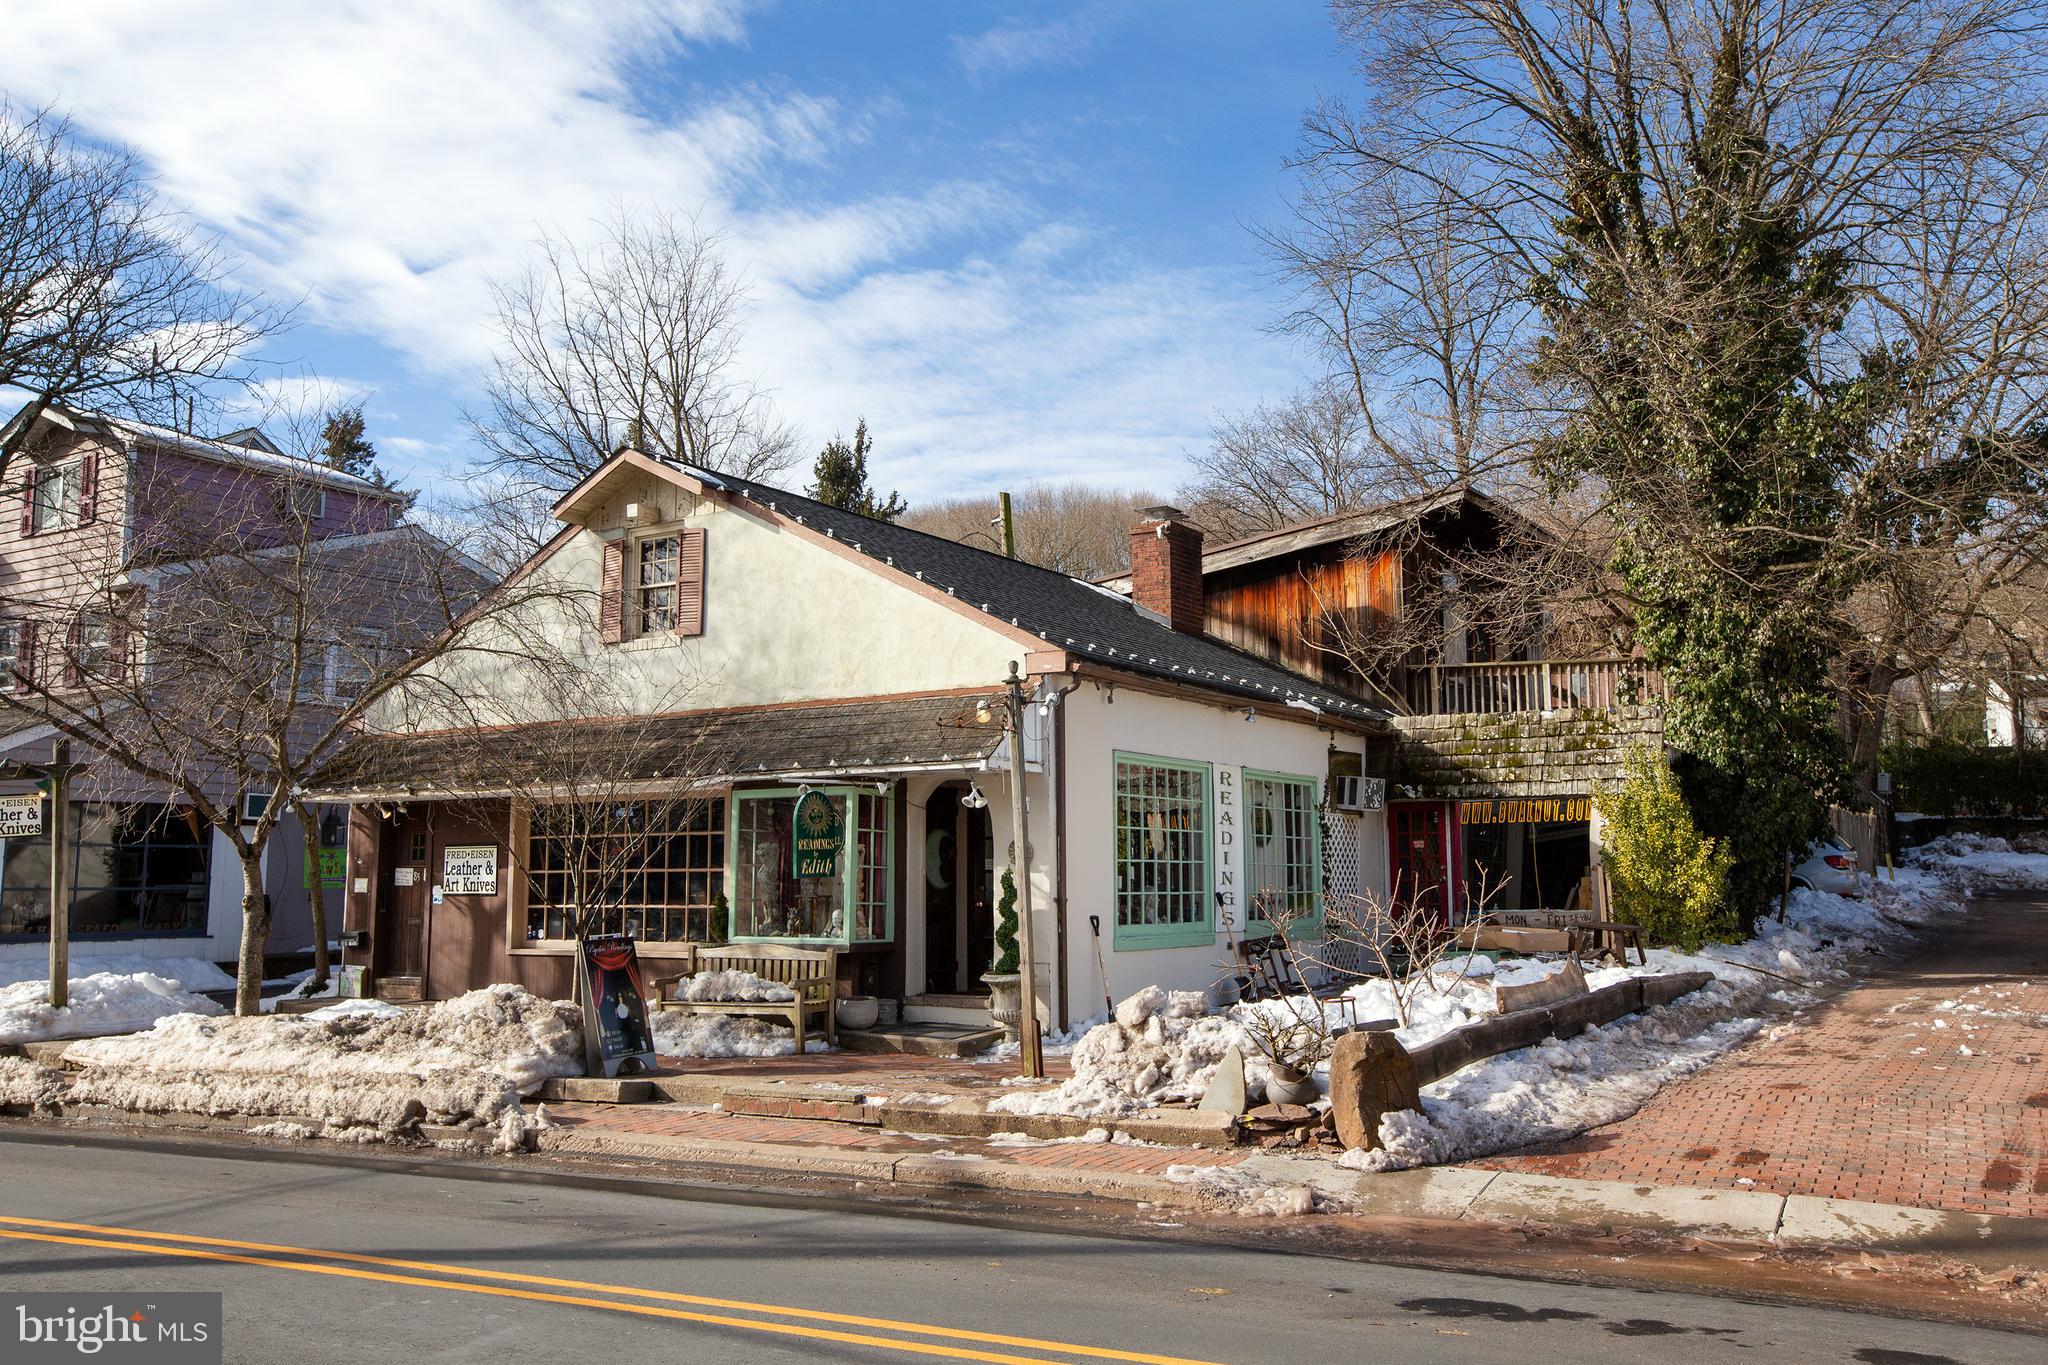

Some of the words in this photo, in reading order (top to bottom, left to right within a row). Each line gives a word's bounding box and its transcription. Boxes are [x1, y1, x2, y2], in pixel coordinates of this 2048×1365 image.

[6, 799, 38, 807] EISEN
[27, 807, 38, 820] &
[0, 821, 41, 834] Knives
[798, 838, 835, 850] READINGS
[1219, 771, 1235, 926] READINGS
[445, 860, 482, 876] Leather
[485, 860, 494, 875] &
[801, 858, 832, 876] Edith
[444, 877, 459, 892] Art
[463, 876, 495, 892] Knives
[1505, 915, 1527, 926] MON
[1547, 915, 1566, 926] FRI
